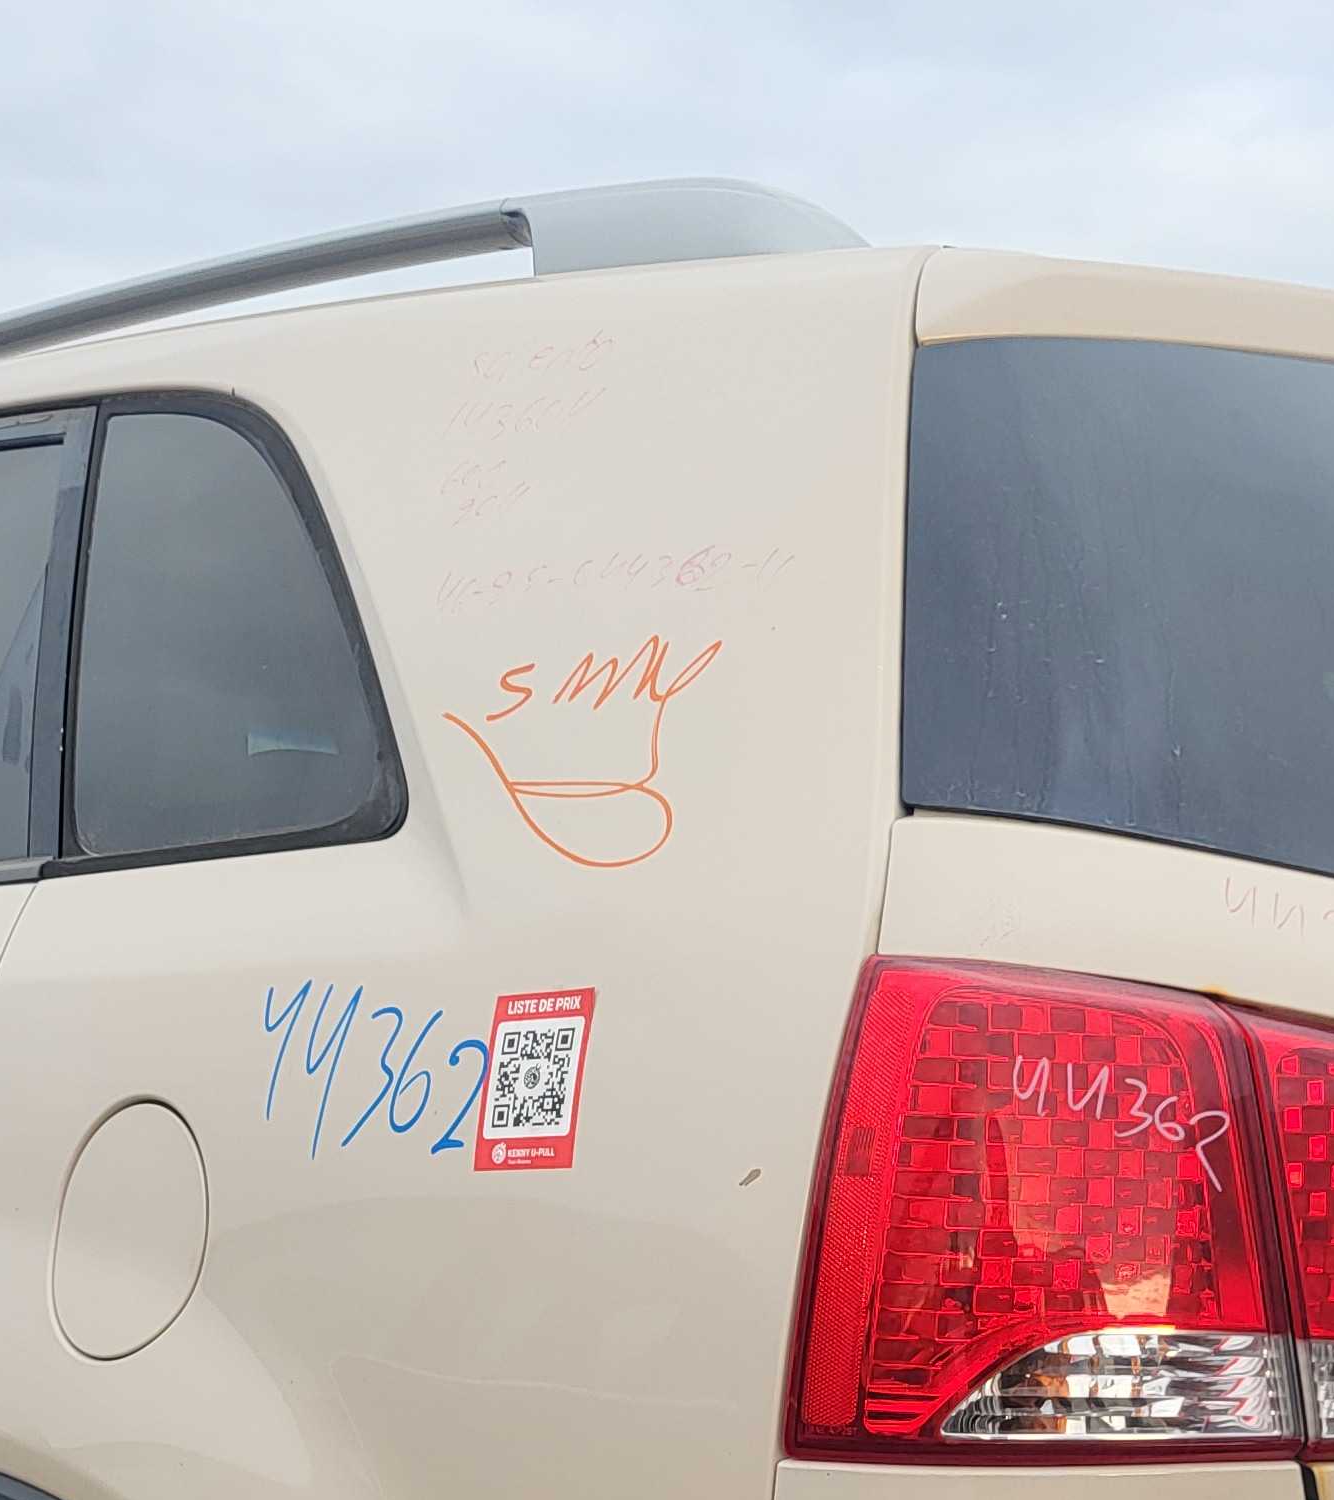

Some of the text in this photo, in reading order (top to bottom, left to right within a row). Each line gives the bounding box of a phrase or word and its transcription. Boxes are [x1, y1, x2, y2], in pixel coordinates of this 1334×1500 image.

[507, 995, 582, 1015] LISTE DE PRIX
